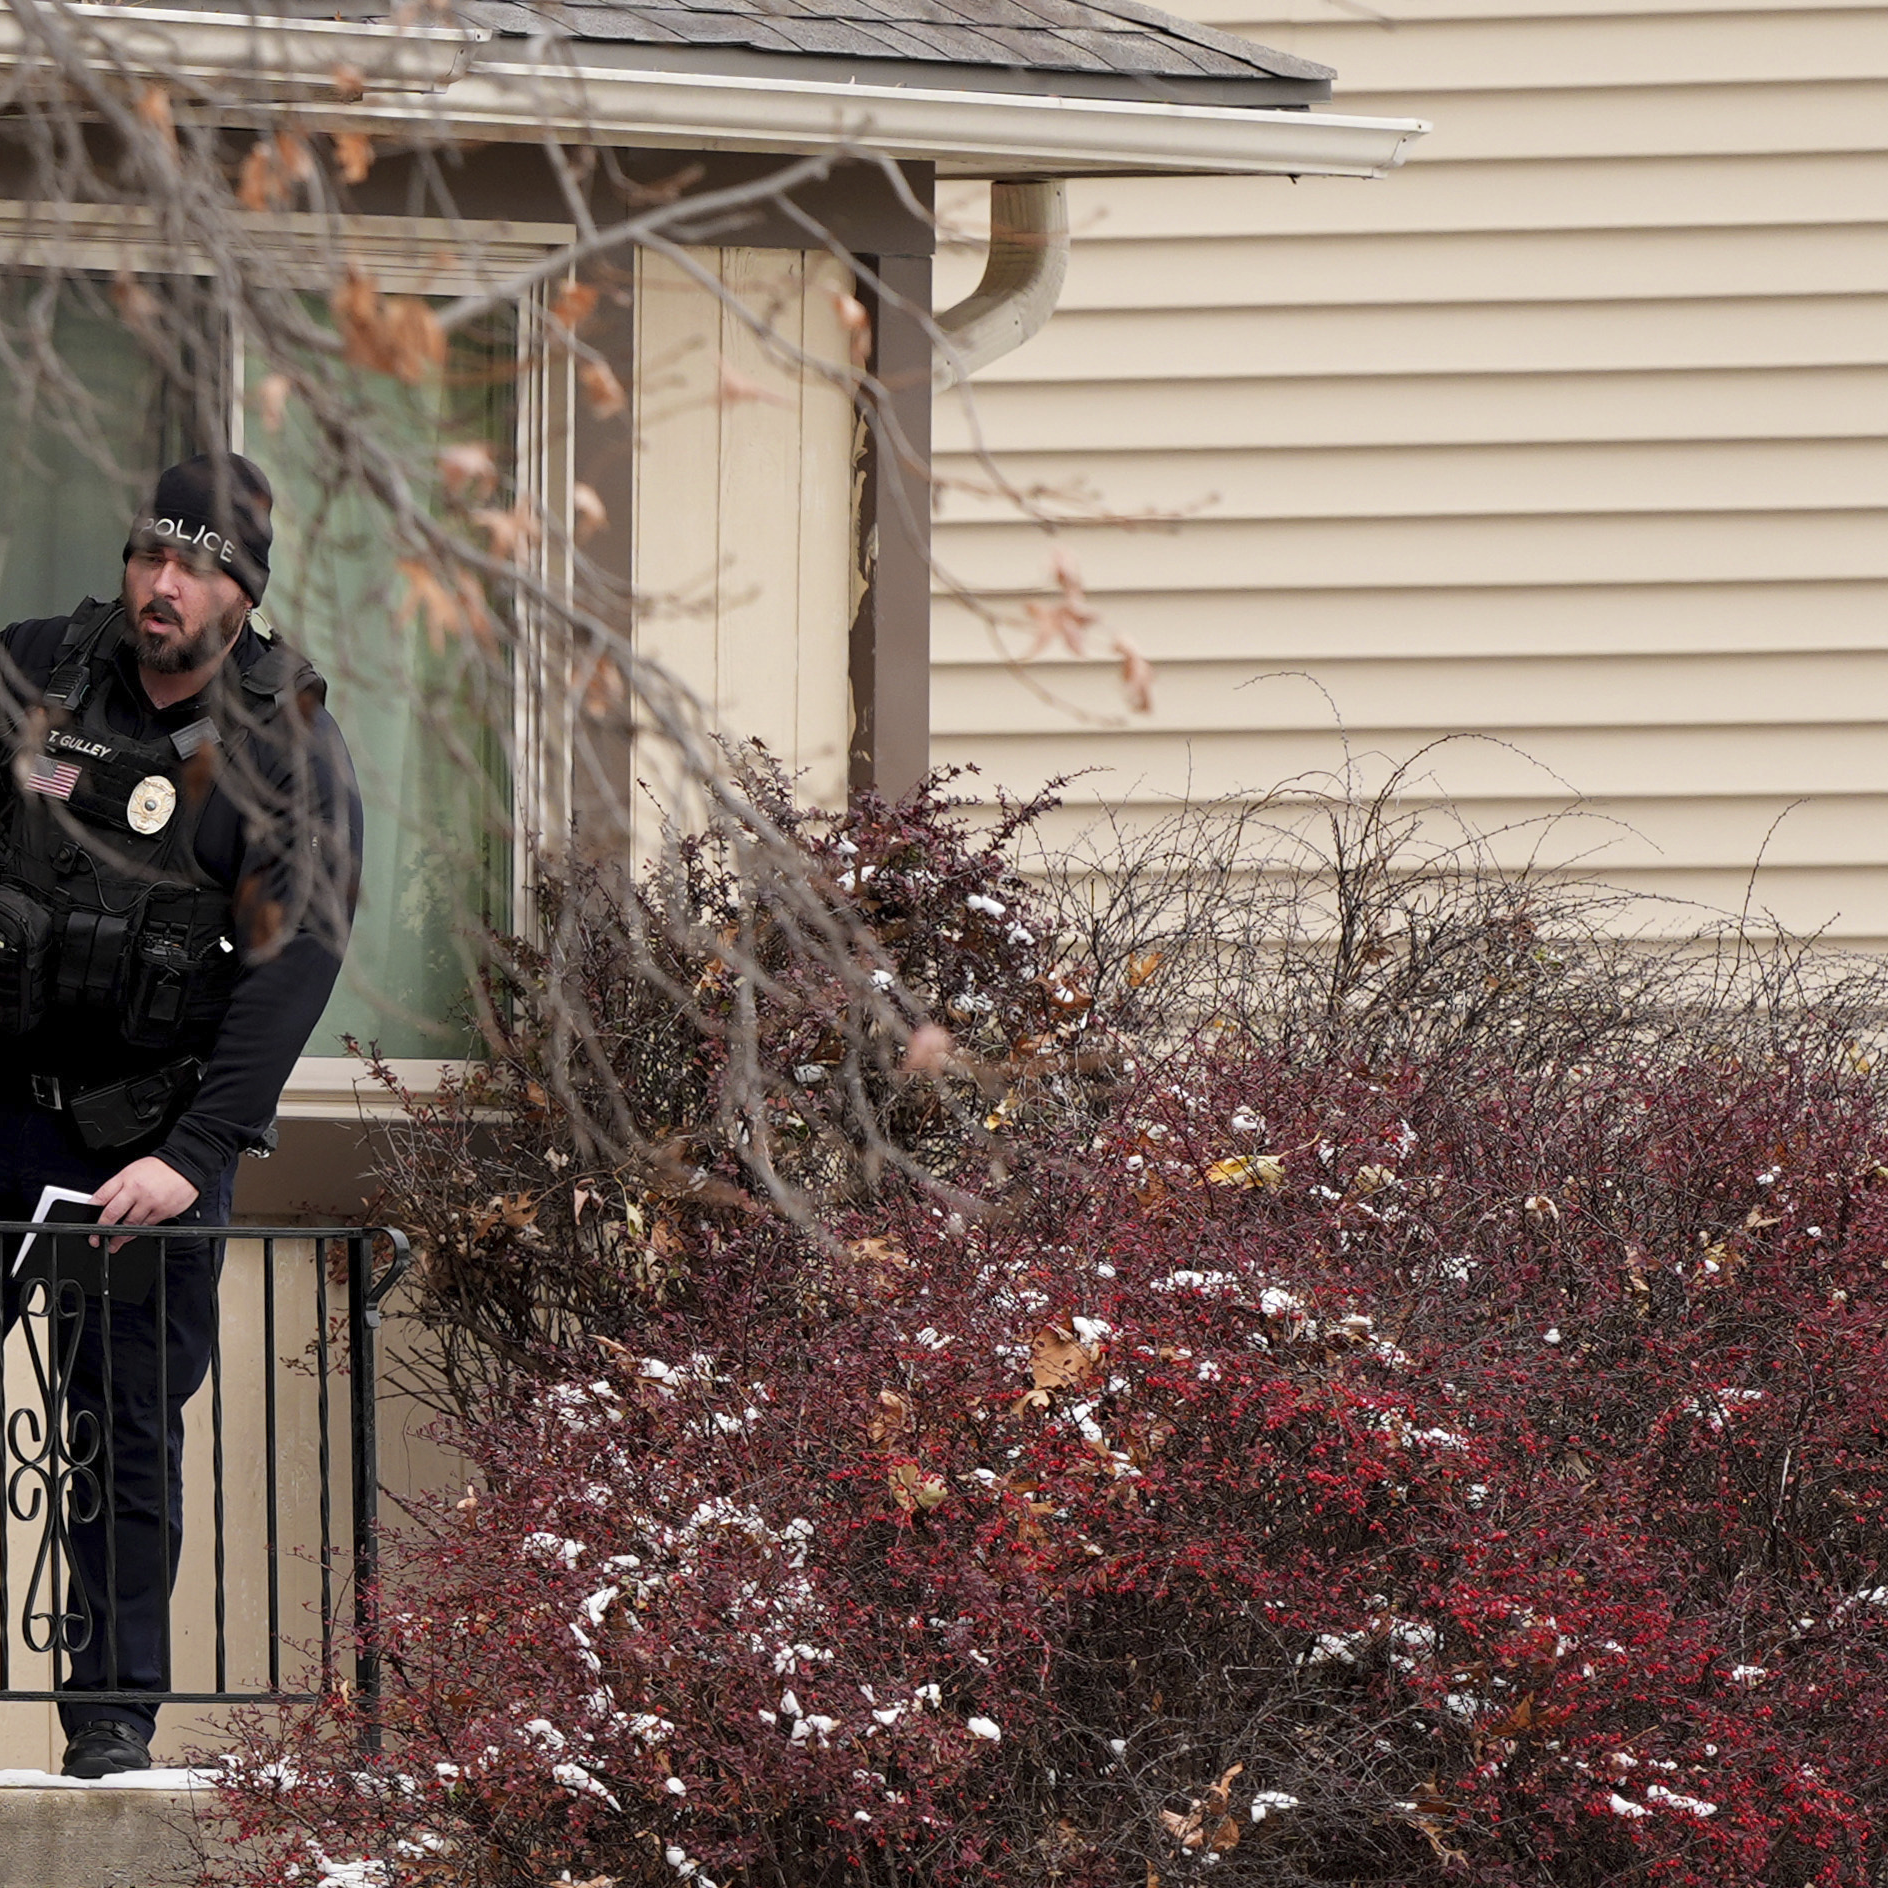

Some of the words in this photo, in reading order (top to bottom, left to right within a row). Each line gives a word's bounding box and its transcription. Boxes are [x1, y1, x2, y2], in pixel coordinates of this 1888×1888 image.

[139, 518, 236, 563] POLICE
[48, 730, 60, 743] T.
[59, 734, 112, 758] GULLEY
